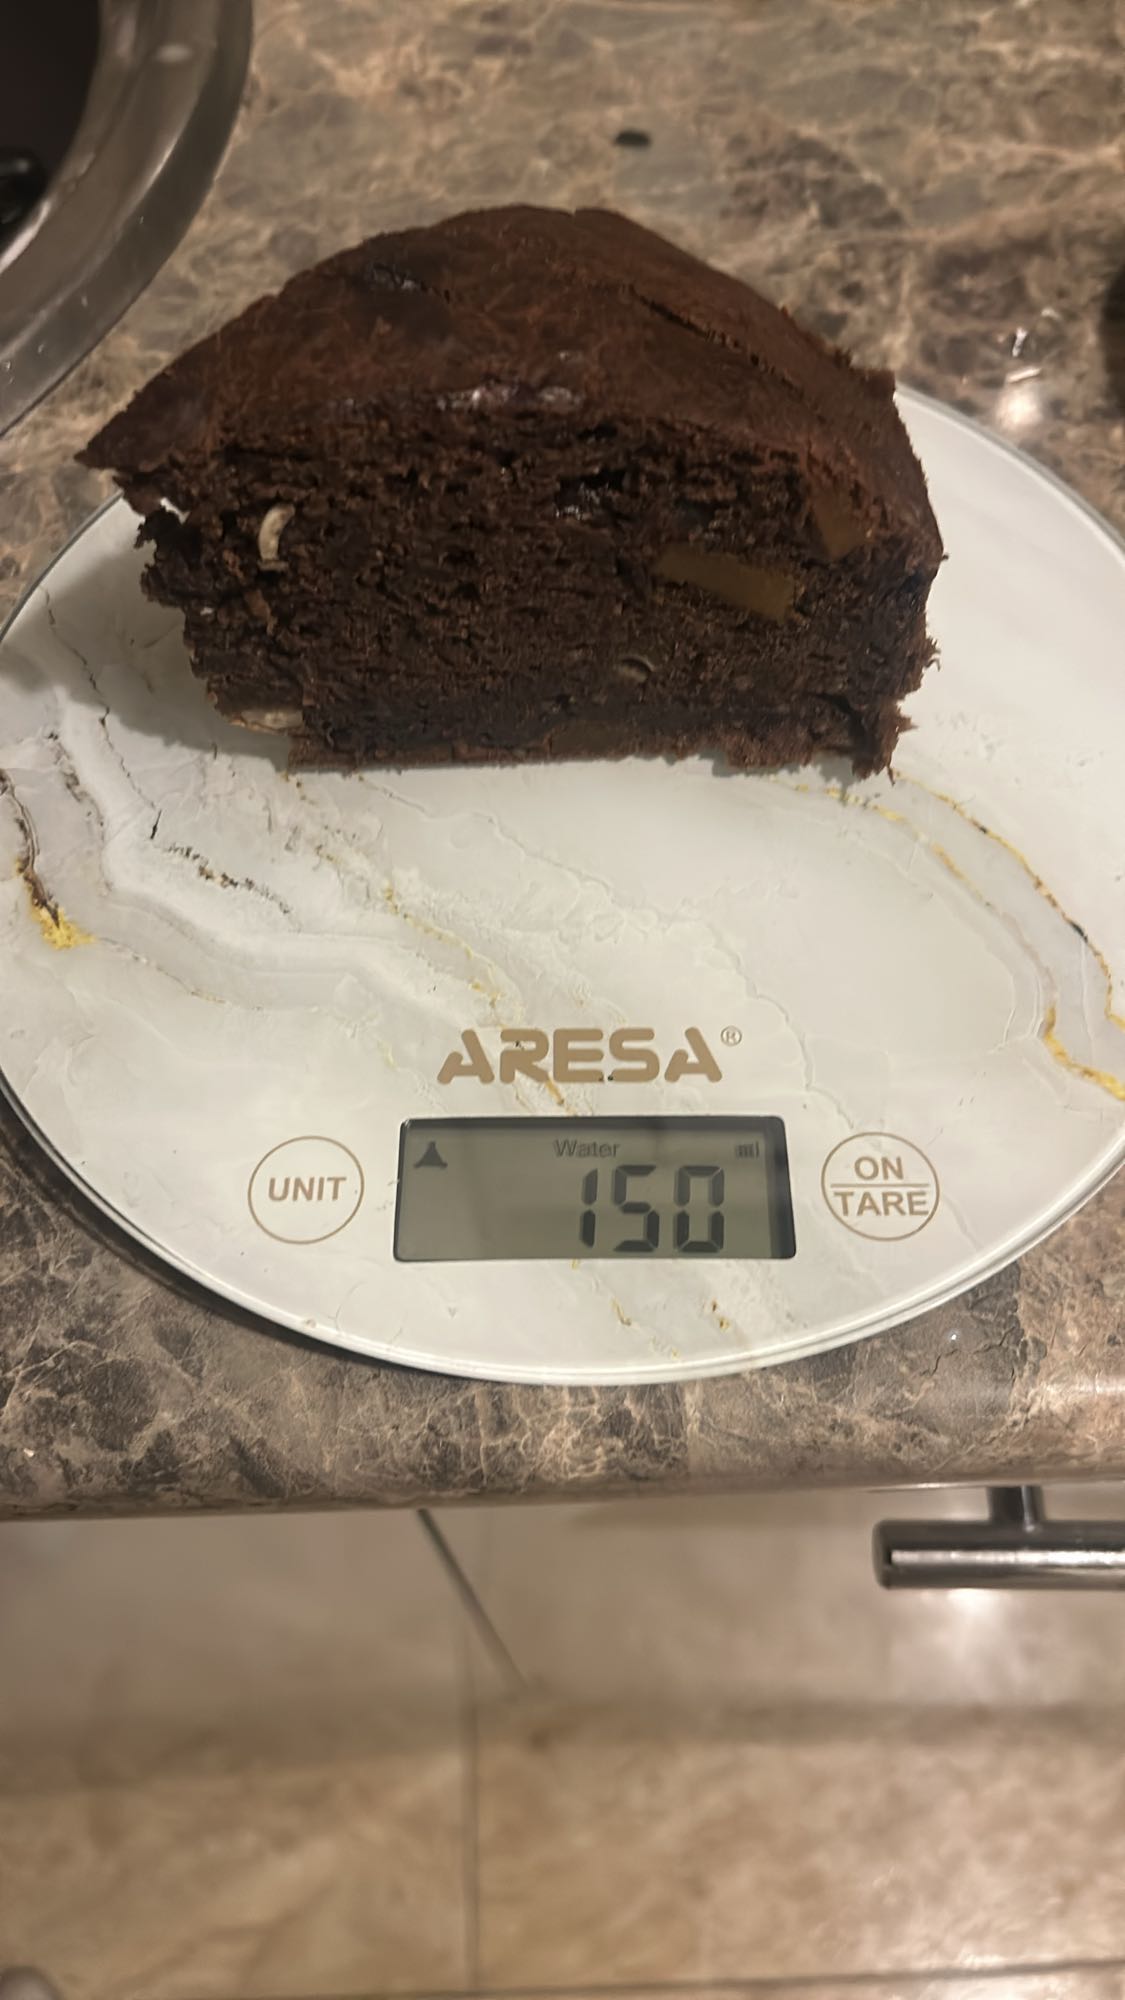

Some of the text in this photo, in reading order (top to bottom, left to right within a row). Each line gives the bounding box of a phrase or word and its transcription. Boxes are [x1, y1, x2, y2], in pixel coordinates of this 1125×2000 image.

[554, 1139, 620, 1158] Water
[854, 1156, 904, 1181] ON
[268, 1177, 347, 1202] UNIT
[580, 1164, 725, 1253] 150
[833, 1191, 929, 1216] TARE
